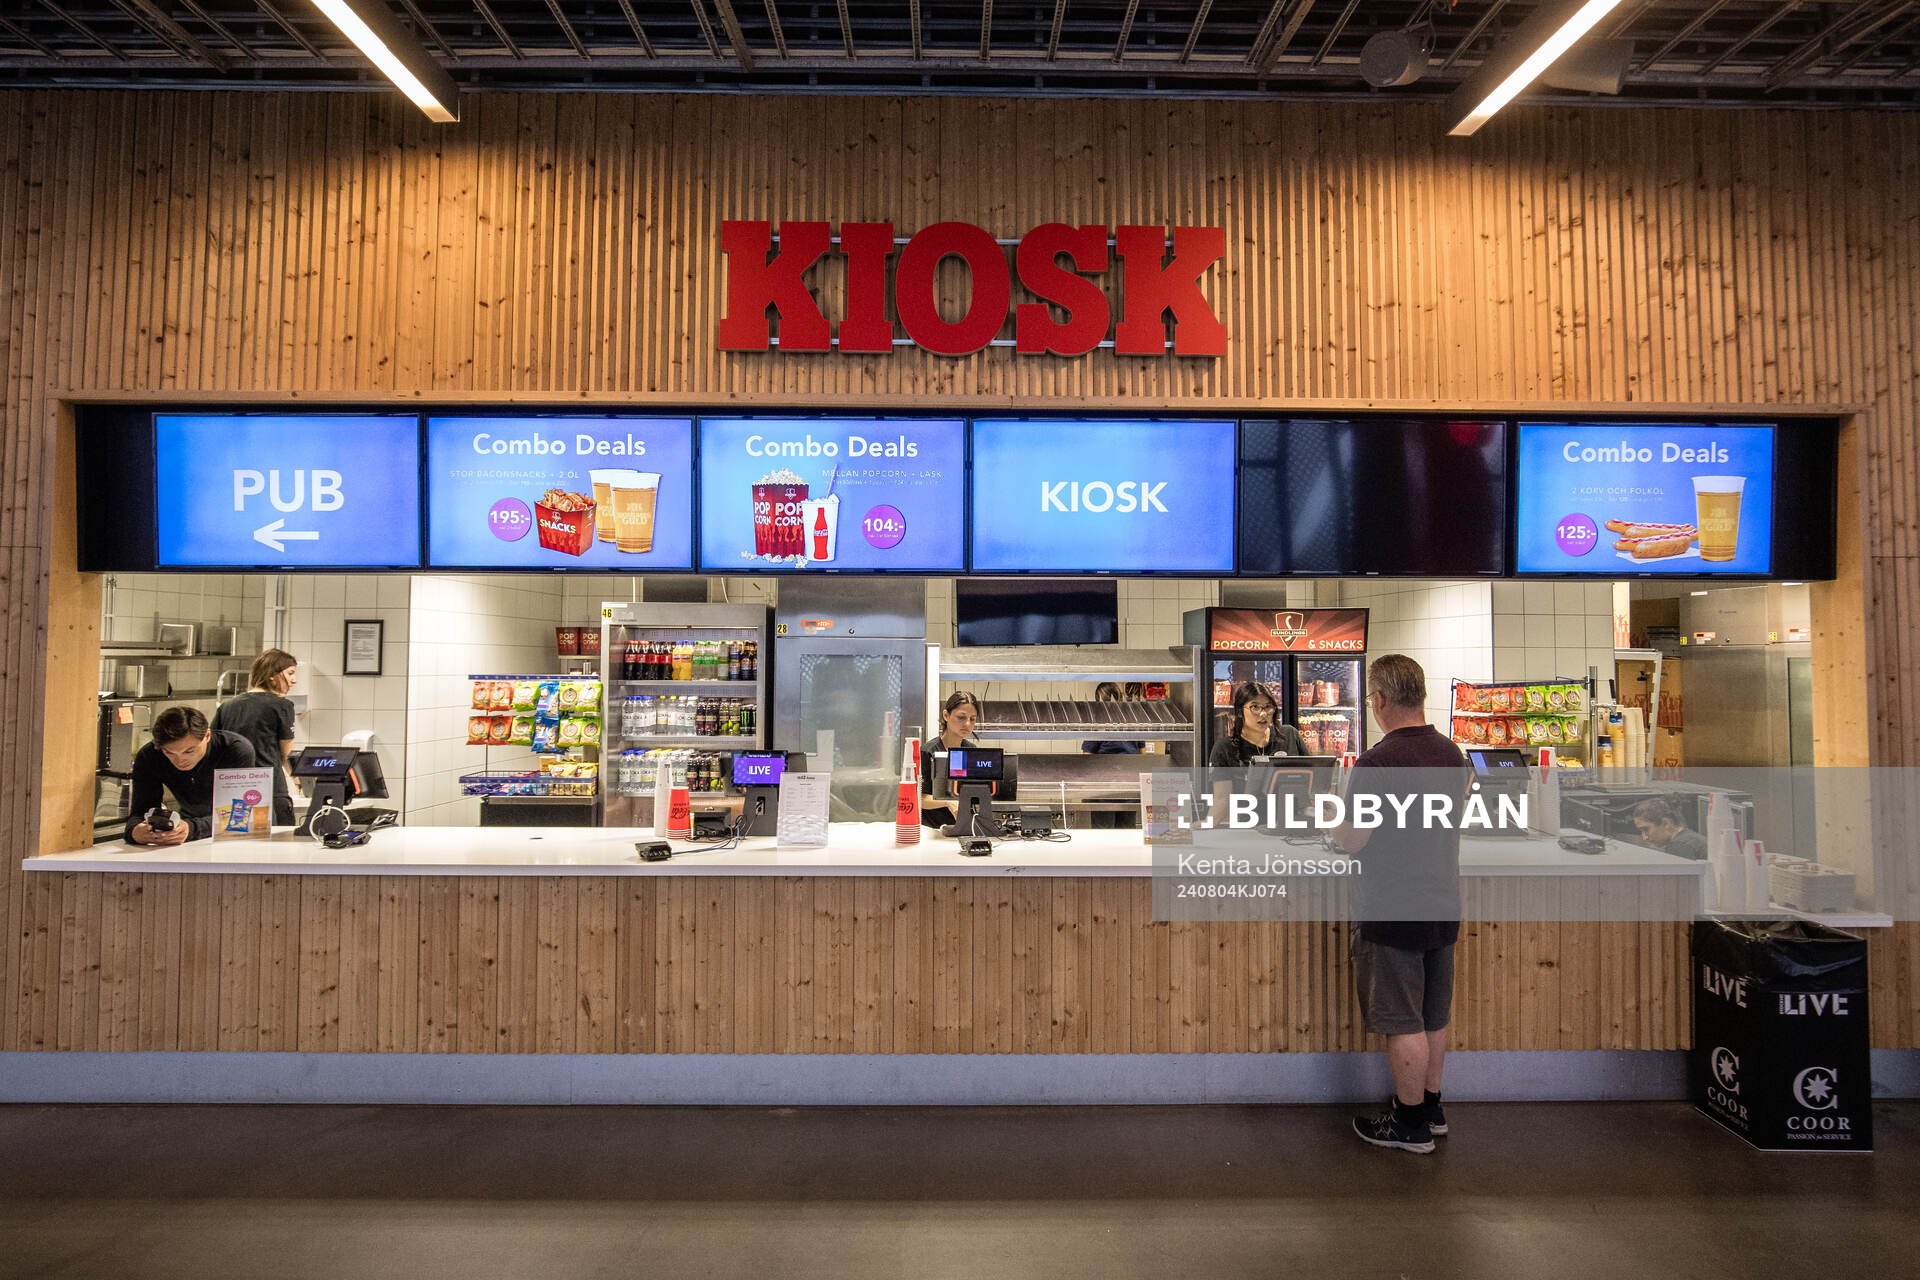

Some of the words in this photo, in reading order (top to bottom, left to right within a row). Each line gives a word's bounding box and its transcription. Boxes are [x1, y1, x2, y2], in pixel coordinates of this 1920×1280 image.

[719, 220, 1226, 357] KIOSK
[473, 433, 566, 456] Combo
[576, 433, 646, 456] Deals
[745, 434, 839, 457] Combo
[848, 434, 918, 457] Deals
[1563, 440, 1653, 463] Combo
[1662, 441, 1729, 463] Deals
[863, 469, 907, 477] POPCORN
[233, 469, 345, 513] PUB
[1041, 480, 1169, 513] KIOSK
[754, 501, 771, 515] POP
[490, 510, 530, 524] 195:-
[754, 515, 772, 525] CORN
[539, 518, 577, 534] SNACKS
[863, 518, 904, 532] 104:-
[1557, 525, 1597, 539] 125:-
[602, 608, 612, 618] 46
[777, 624, 787, 634] 28
[1213, 640, 1270, 650] POPCORN
[1308, 639, 1316, 648] &
[1319, 639, 1363, 649] SNACKS
[1328, 729, 1347, 737] POP
[314, 758, 337, 768] LIVE
[749, 765, 771, 775] LIVE
[976, 760, 993, 768] LIVE
[1703, 964, 1747, 1009] LIVE
[1784, 993, 1848, 1016] LIVE
[1707, 1086, 1748, 1120] COOR
[1786, 1116, 1852, 1130] COOR
